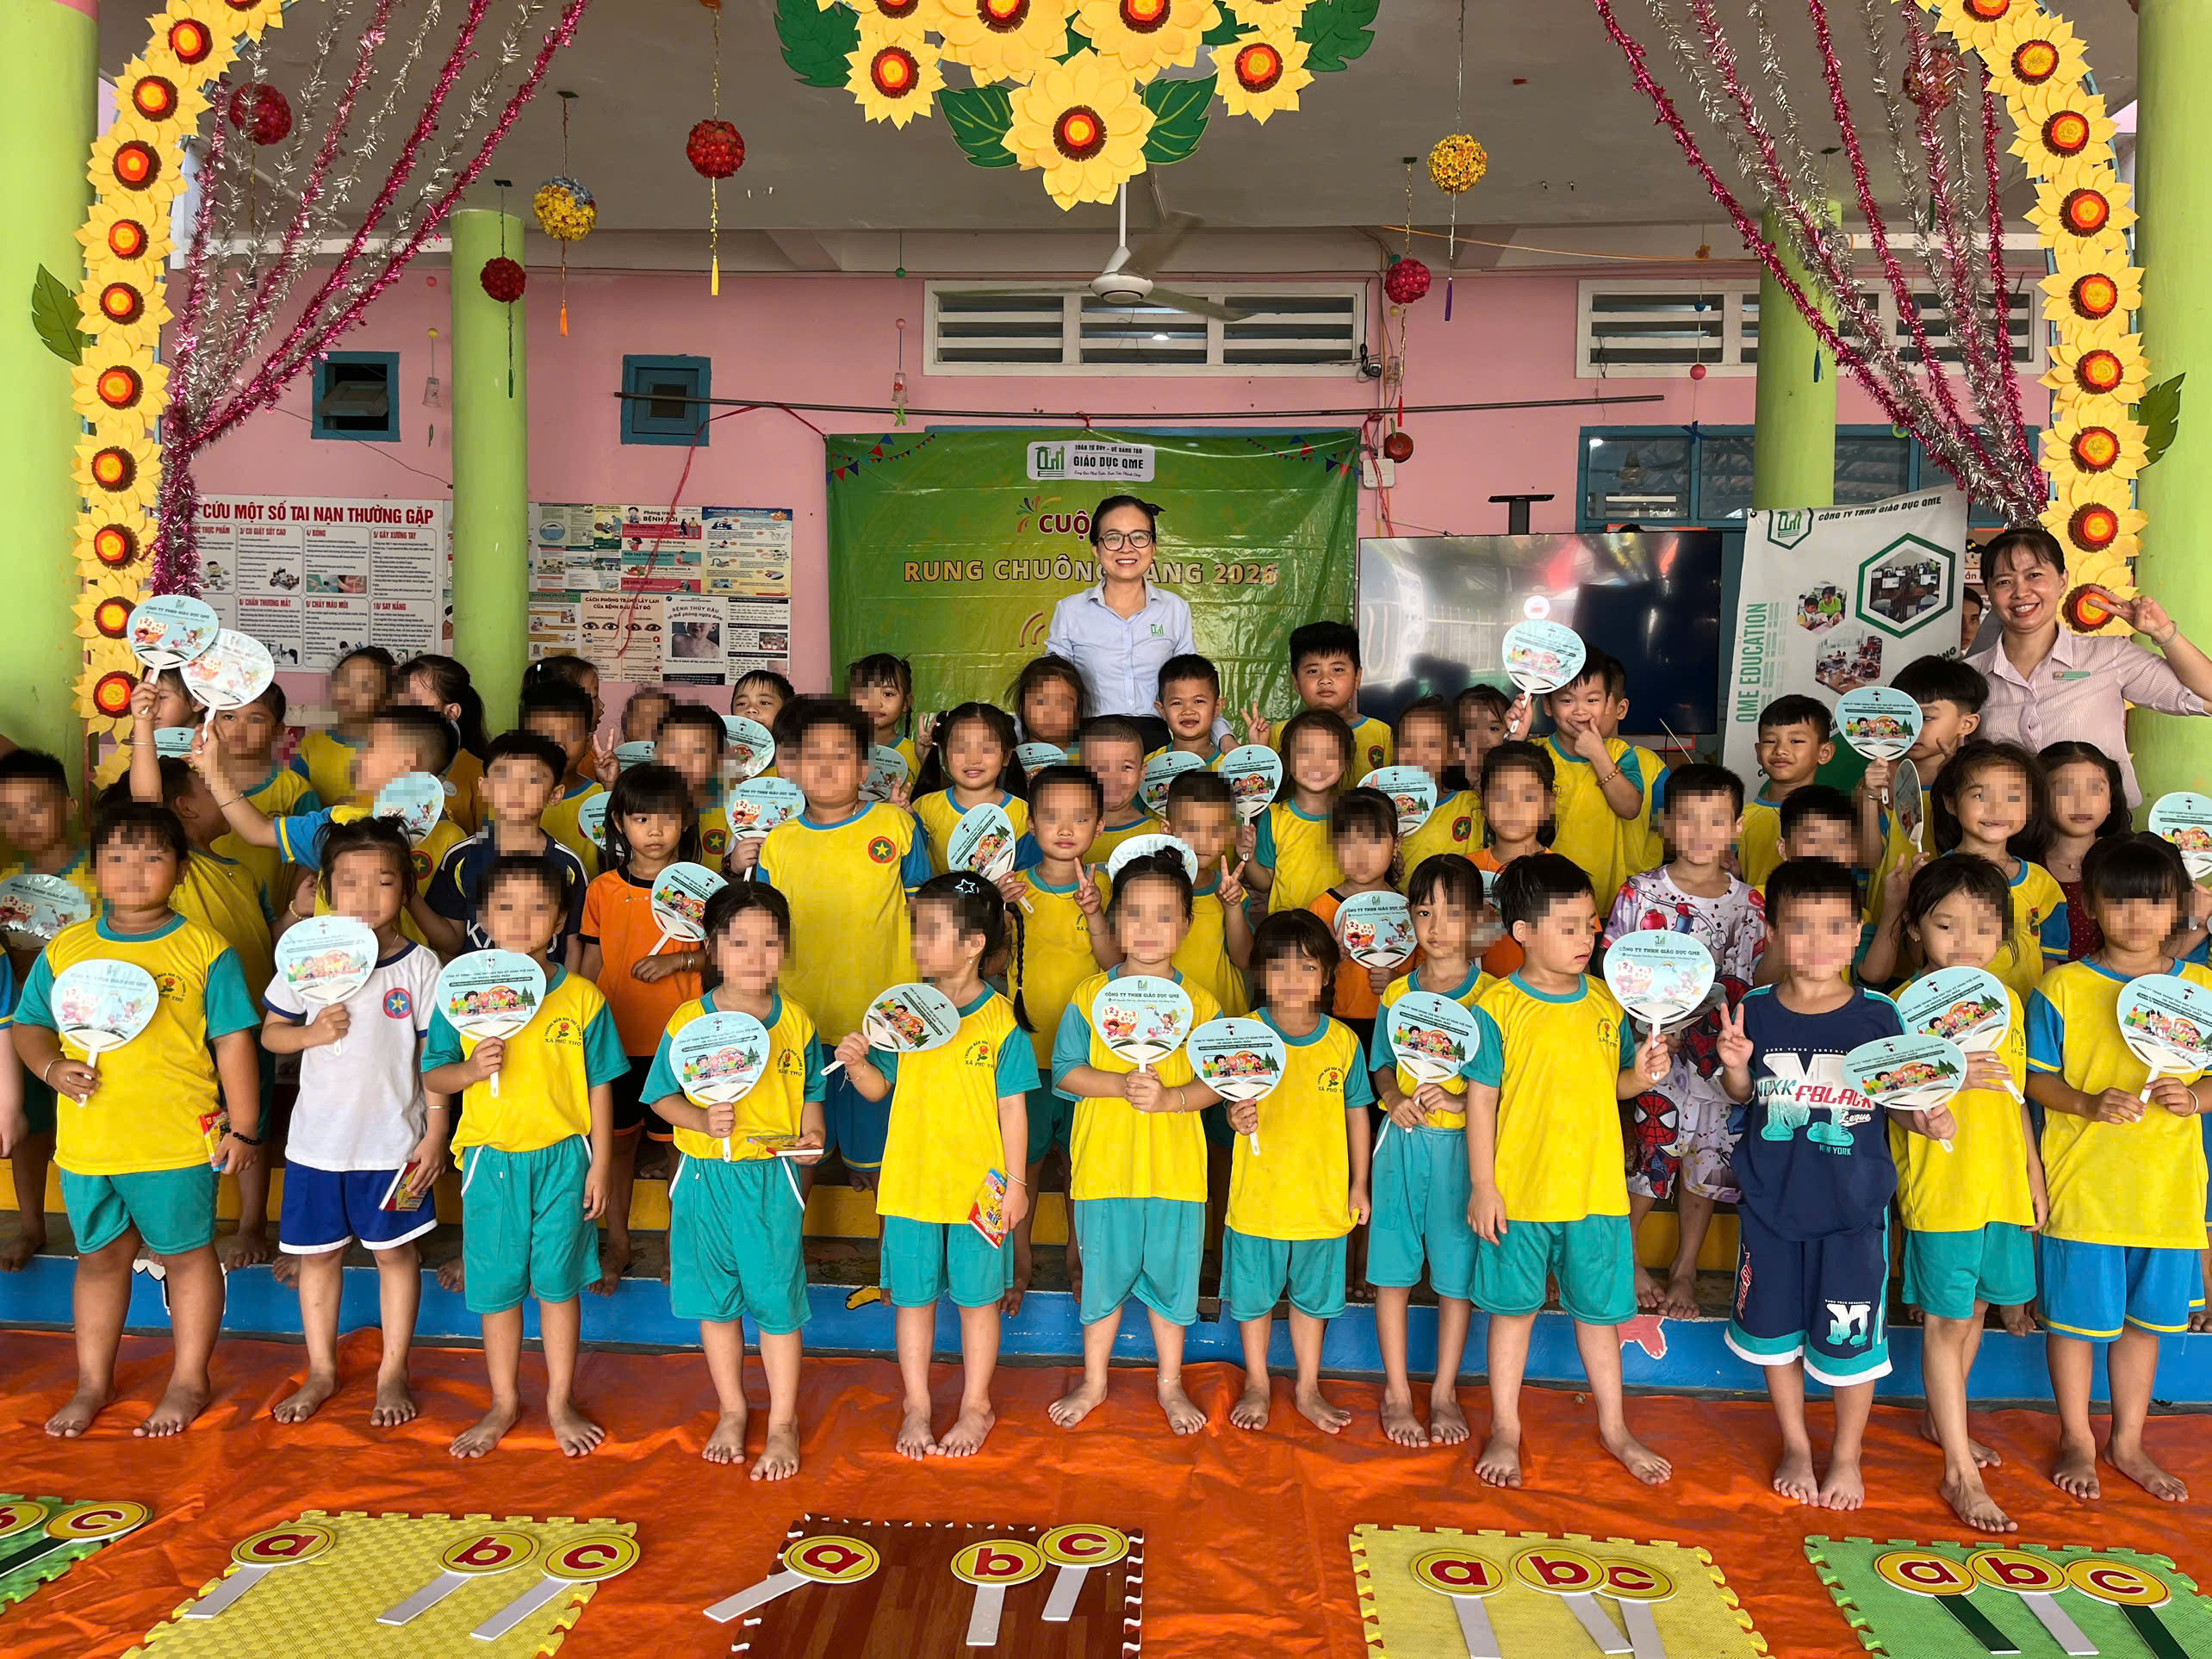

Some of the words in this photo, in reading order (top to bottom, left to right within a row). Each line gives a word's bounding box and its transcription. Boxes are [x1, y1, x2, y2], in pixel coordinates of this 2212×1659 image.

[1073, 455, 1096, 467] GIÁO
[1099, 457, 1118, 469] DỤC
[1122, 458, 1144, 469] QME
[203, 500, 231, 519] CỨU
[234, 501, 264, 523] MỘT
[268, 500, 286, 521] SỐ
[290, 506, 309, 521] TAI
[314, 506, 344, 525] NẠN
[347, 505, 402, 524] THƯỜNG
[406, 506, 434, 527] GẶP
[1818, 511, 1841, 521] CÔNG
[1855, 507, 1876, 516] TNHH
[1878, 502, 1899, 513] GIÁO
[1901, 500, 1919, 510] DỤC
[1921, 496, 1942, 506] QME
[407, 531, 417, 540] TAY
[1038, 510, 1092, 541] CUỘ
[904, 560, 984, 581] RUNG
[1212, 562, 1278, 587] 2026
[1739, 603, 1768, 685] EDUCATION
[1736, 690, 1759, 723] QME
[1832, 1146, 1851, 1155] YORK
[71, 1509, 122, 1530] c
[253, 1534, 317, 1556] a
[452, 1538, 513, 1566] b
[562, 1543, 622, 1569] c
[1059, 1532, 1107, 1556] c
[802, 1544, 865, 1575] a
[974, 1548, 1024, 1576] b
[1528, 1556, 1589, 1585] b
[1983, 1557, 2048, 1585] b
[1430, 1560, 1489, 1586] a
[1608, 1565, 1656, 1589] c
[1898, 1561, 1958, 1584] a
[2090, 1569, 2145, 1594] c
